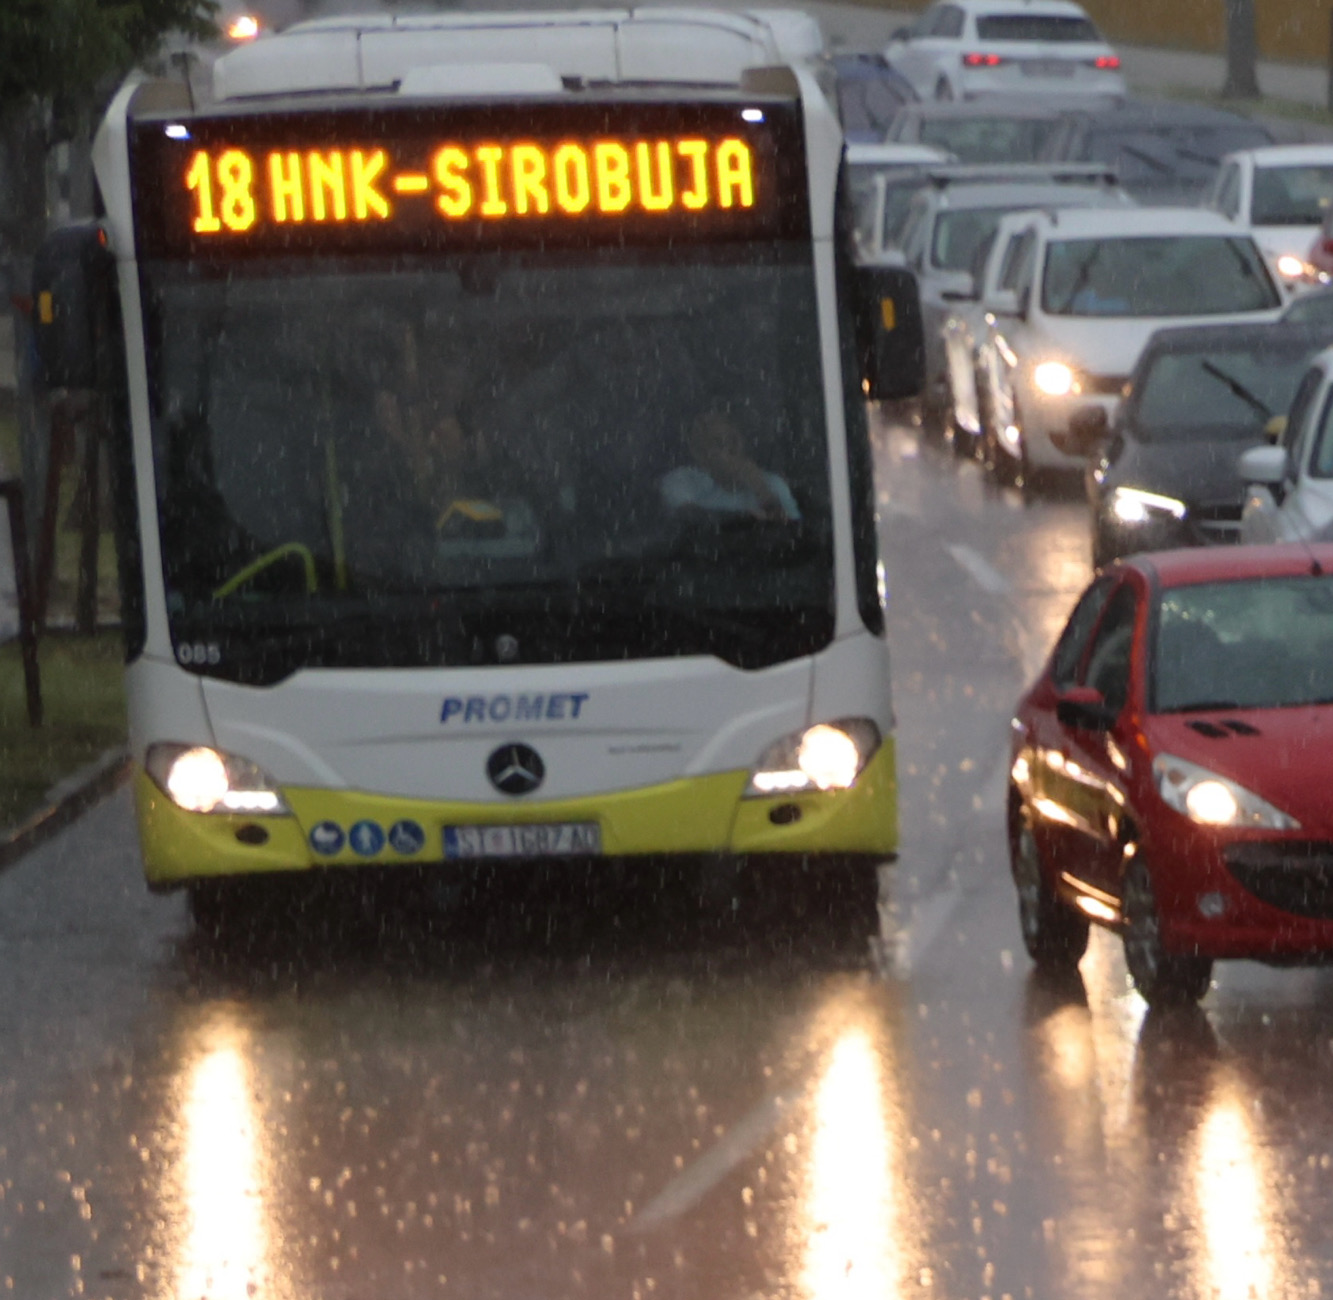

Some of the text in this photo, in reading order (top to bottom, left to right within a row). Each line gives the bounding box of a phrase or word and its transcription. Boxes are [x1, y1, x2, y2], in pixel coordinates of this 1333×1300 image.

[185, 138, 754, 233] 18 HNK-SIROBUJA
[439, 692, 590, 724] PROMET
